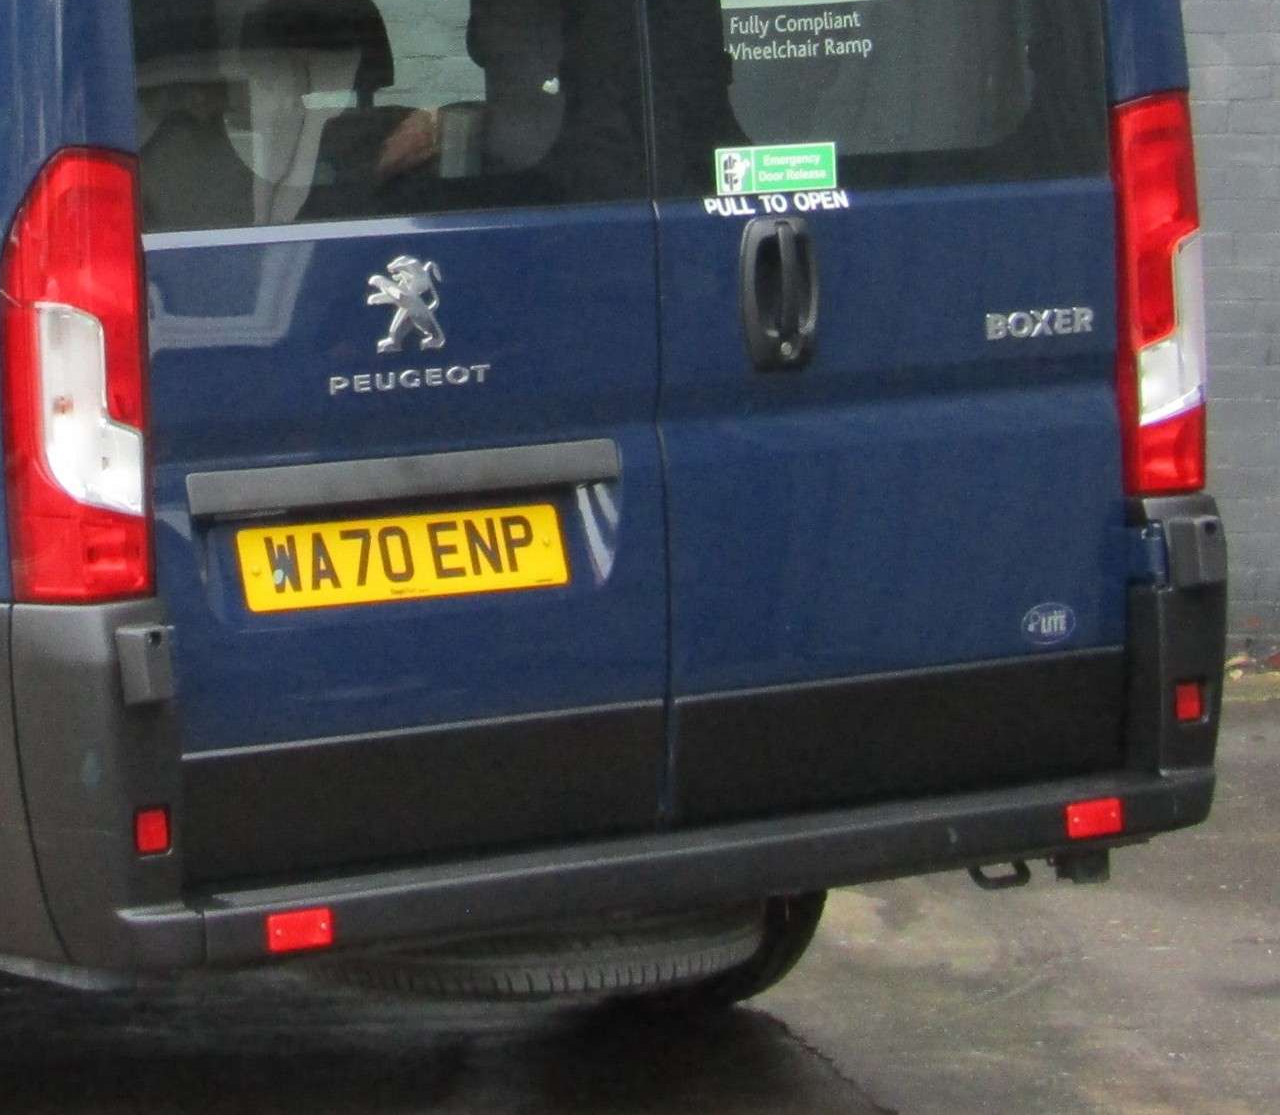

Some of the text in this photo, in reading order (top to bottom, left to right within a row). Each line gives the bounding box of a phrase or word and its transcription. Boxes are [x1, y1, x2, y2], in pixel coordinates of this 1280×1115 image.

[729, 11, 861, 39] Fully Compliant
[824, 38, 873, 59] Ramp
[762, 153, 821, 168] Emergency
[758, 170, 785, 182] Door
[703, 190, 850, 217] PULL TO OPEN
[985, 306, 1095, 341] BOXER
[328, 364, 492, 396] PEUGEOT
[263, 514, 535, 595] WA70 ENP
